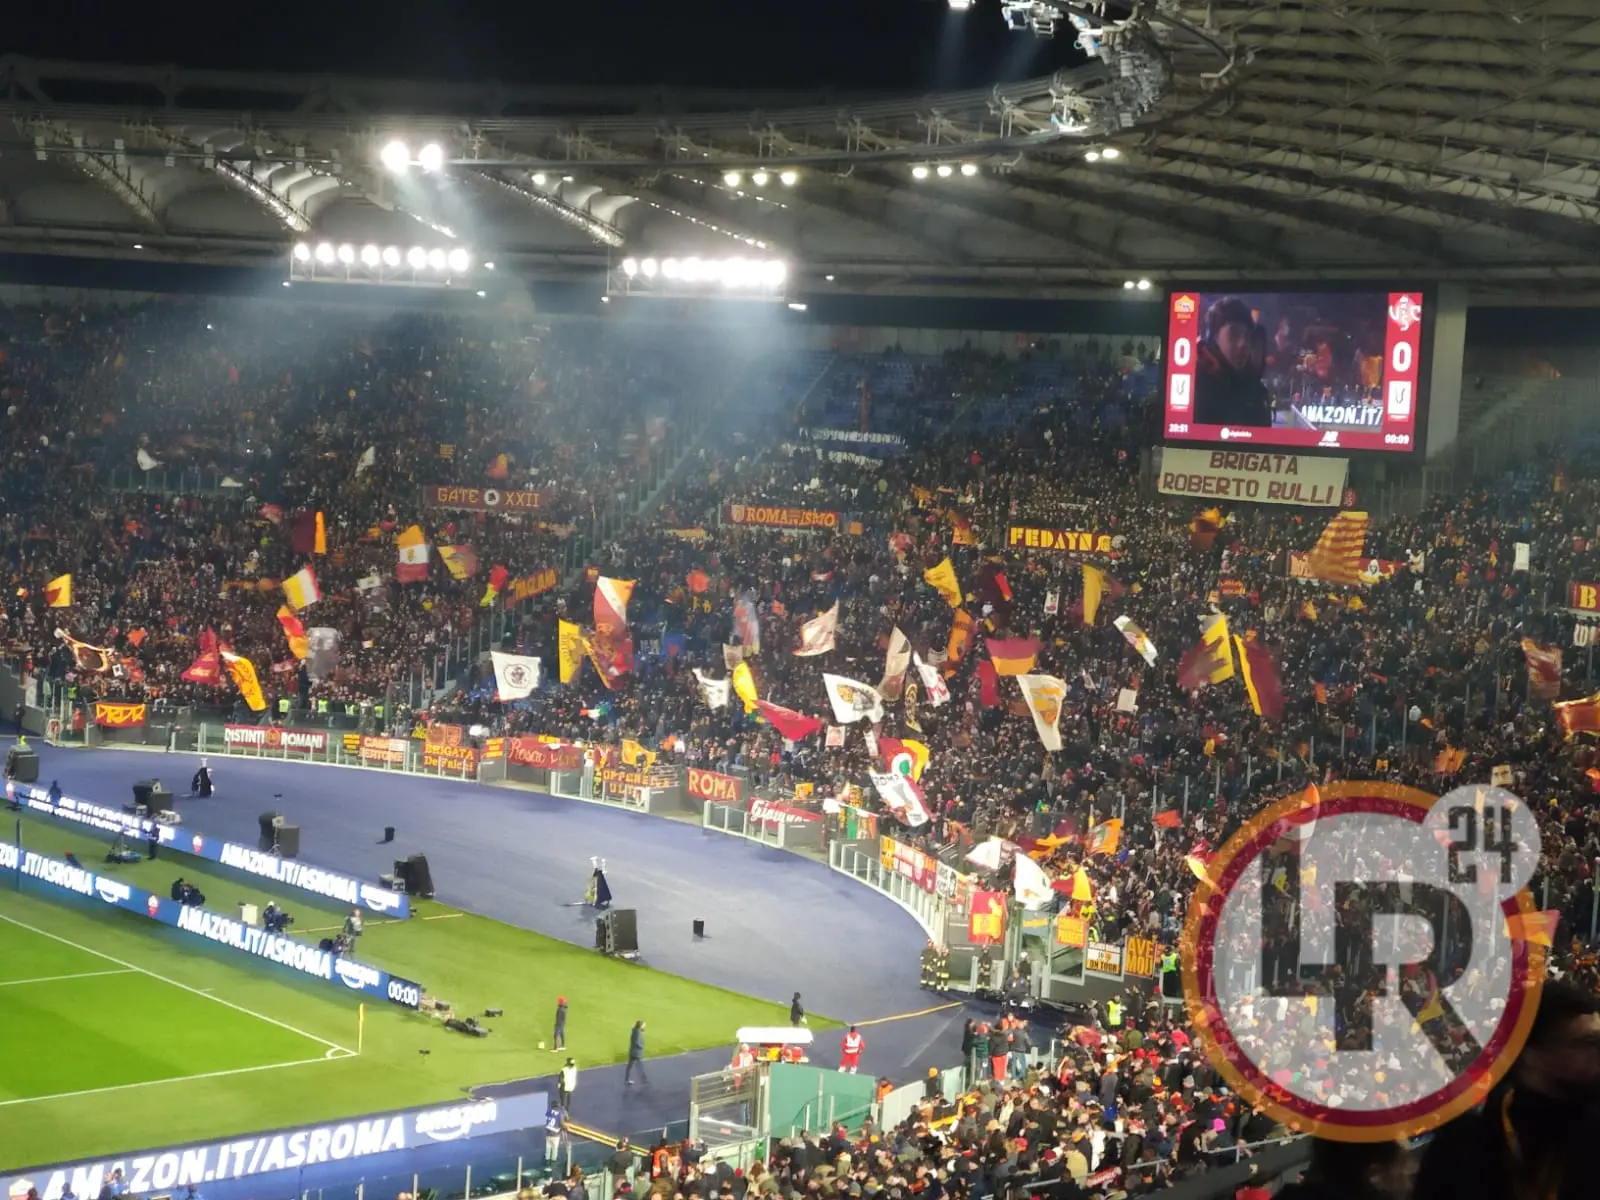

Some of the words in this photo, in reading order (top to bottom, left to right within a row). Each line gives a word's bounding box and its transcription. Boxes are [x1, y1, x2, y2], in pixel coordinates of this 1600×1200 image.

[1174, 338, 1190, 366] 0
[1392, 341, 1412, 372] 0
[1210, 451, 1298, 475] BRIGATA
[437, 487, 479, 503] GATE
[505, 491, 540, 507] XXII
[1163, 473, 1259, 498] ROBERTO
[1267, 480, 1334, 505] RULLI
[224, 727, 265, 743] DISTINTI
[280, 731, 323, 748] ROMANI
[425, 743, 474, 760] BRIGATA
[688, 769, 737, 800] ROMA
[219, 842, 358, 905] AMAZON.IT/ASROMA
[177, 905, 332, 980] AMAZON.IT/ASROMA
[1128, 936, 1154, 958] AVE
[1126, 955, 1154, 976] MOU
[388, 980, 418, 1007] 00:00
[416, 1102, 498, 1142] amazon
